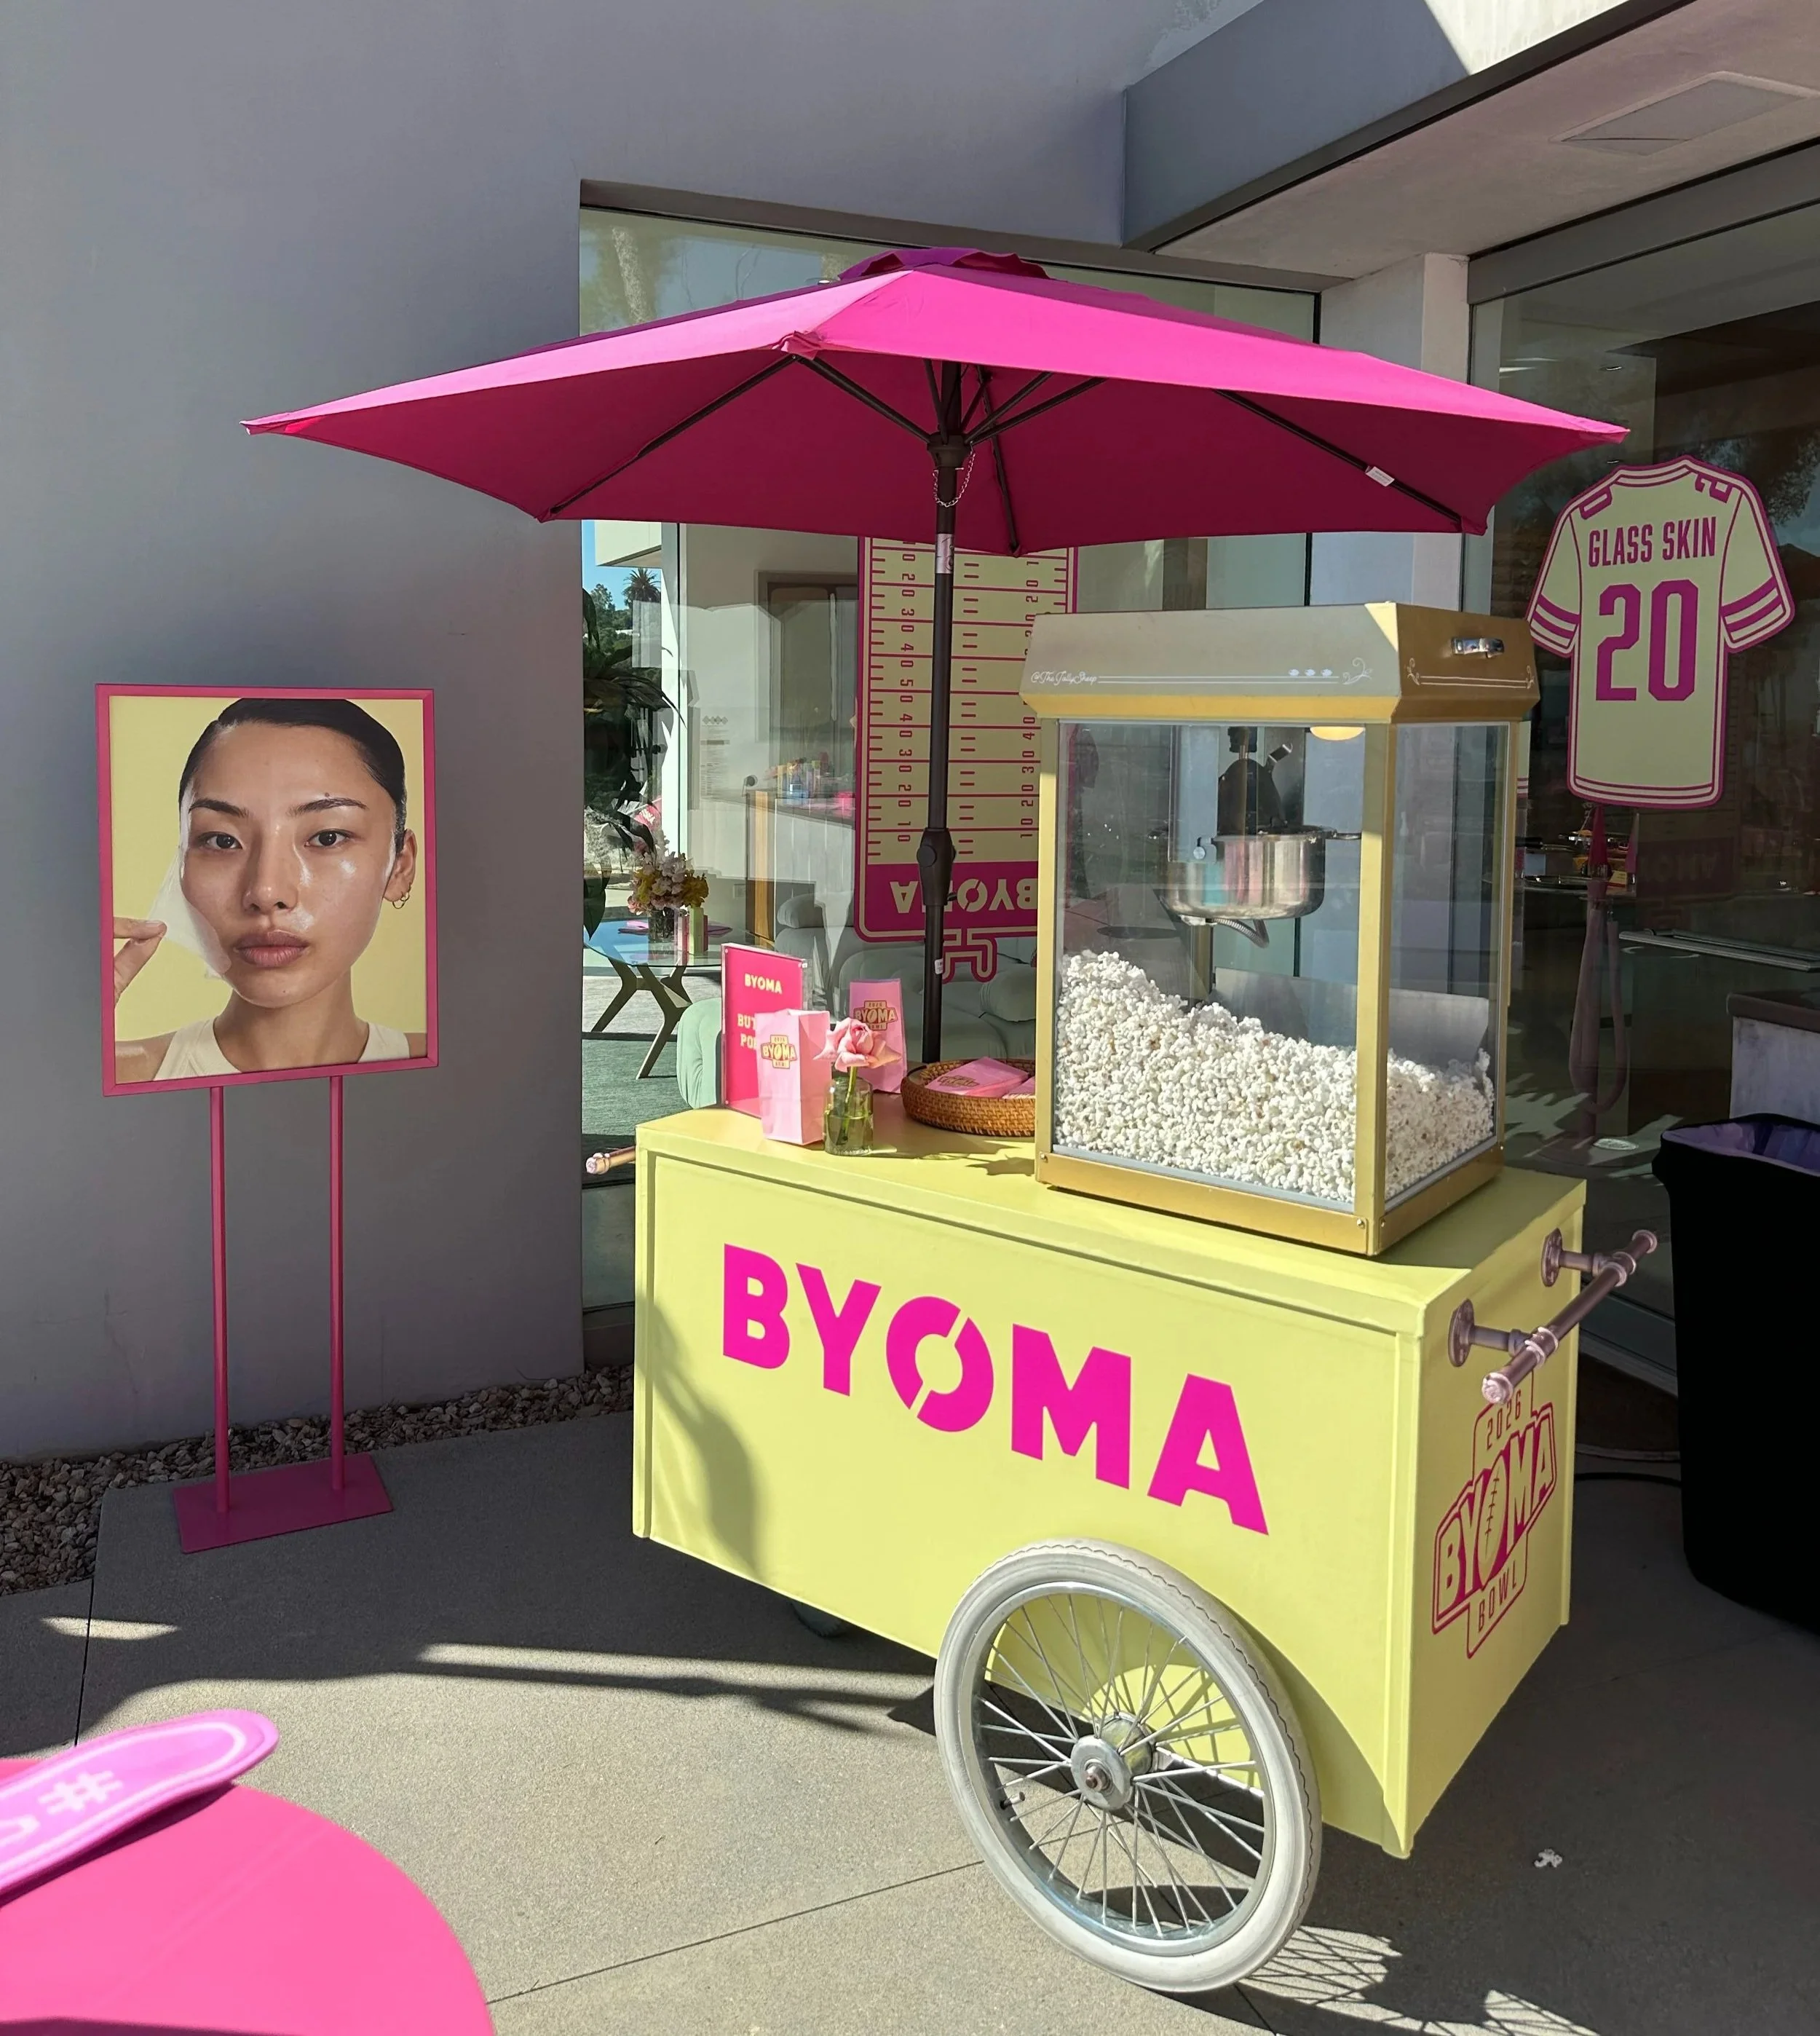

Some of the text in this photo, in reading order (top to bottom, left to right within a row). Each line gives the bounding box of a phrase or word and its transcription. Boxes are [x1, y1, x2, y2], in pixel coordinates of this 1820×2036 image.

[1588, 517, 1717, 567] GLASS SKIN
[1596, 579, 1698, 701] 20
[744, 973, 783, 995] BYOMA
[855, 1008, 896, 1024] BYOMA
[762, 1043, 796, 1060] BYOMA
[723, 1243, 1269, 1535] BYOMA
[1486, 1389, 1522, 1451] 2026
[1437, 1413, 1554, 1621] BYOMA
[1478, 1560, 1517, 1633] BOWL
